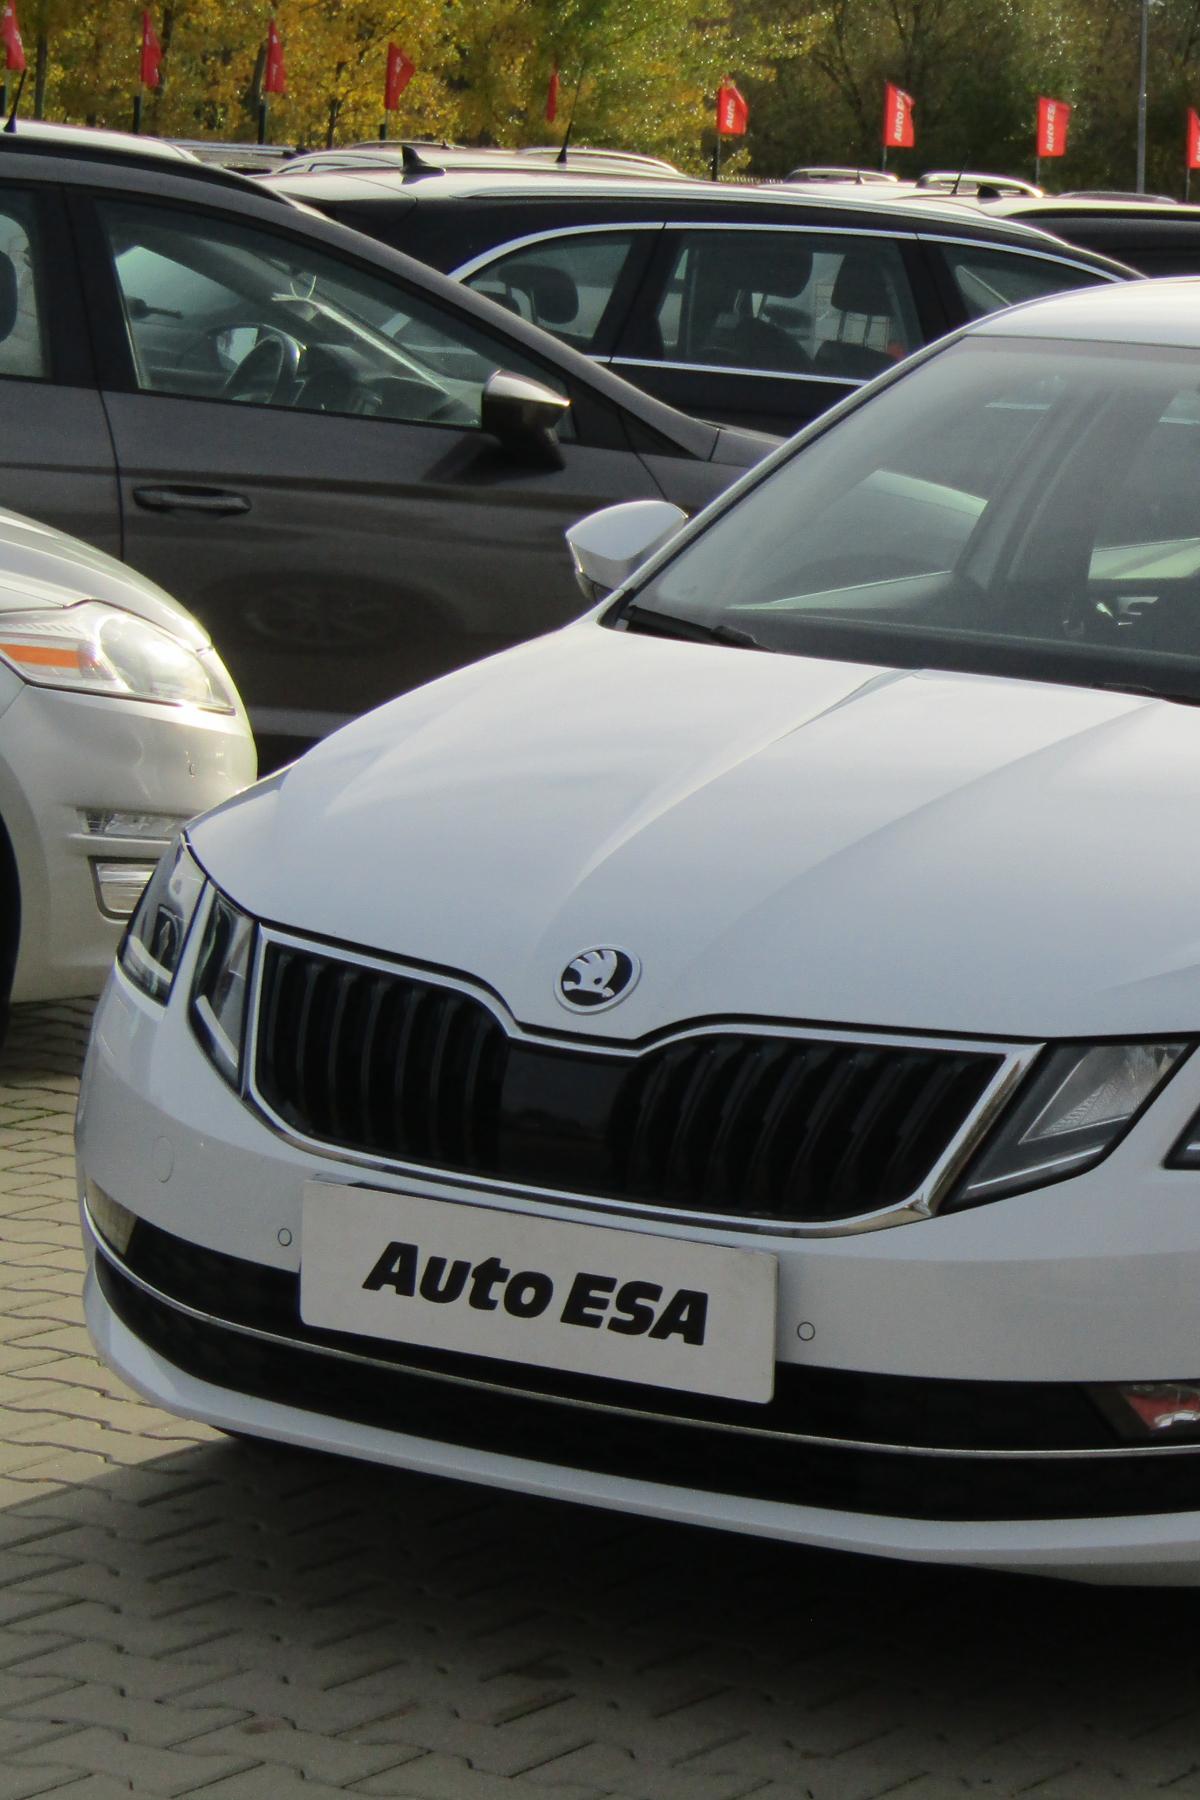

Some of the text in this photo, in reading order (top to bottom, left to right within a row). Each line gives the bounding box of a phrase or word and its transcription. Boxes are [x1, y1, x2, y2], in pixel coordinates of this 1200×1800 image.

[726, 98, 736, 129] Auto
[894, 111, 904, 142] Auto
[1046, 122, 1054, 152] Auto
[361, 1241, 709, 1346] Auto ESA
